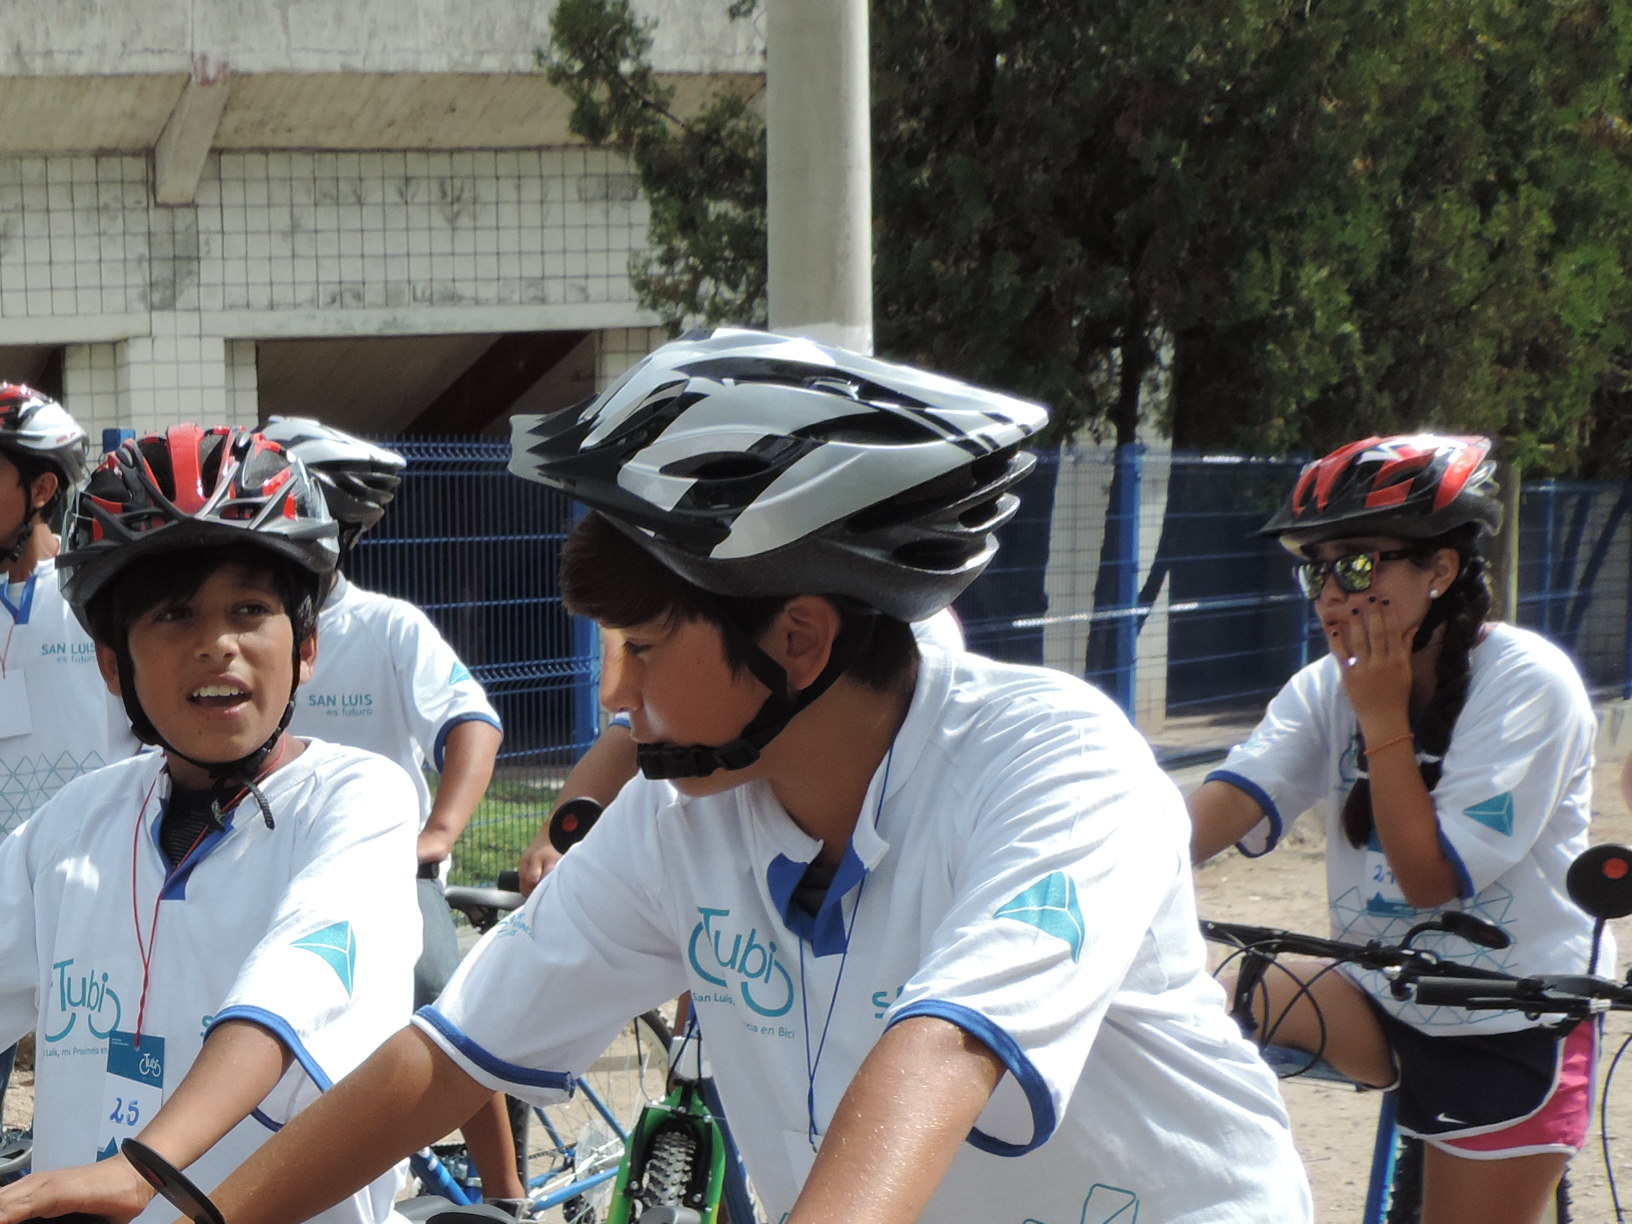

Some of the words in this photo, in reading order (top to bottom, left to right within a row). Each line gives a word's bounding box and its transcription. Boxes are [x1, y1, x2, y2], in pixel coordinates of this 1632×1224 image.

[41, 643, 66, 656] SAN
[308, 694, 337, 707] SAN
[341, 693, 374, 707] LUIS
[326, 709, 339, 717] es
[342, 707, 374, 717] futuro
[53, 957, 109, 1013] Tubi
[714, 993, 736, 1006] Luis,
[760, 1026, 775, 1036] en
[109, 1096, 140, 1127] 25
